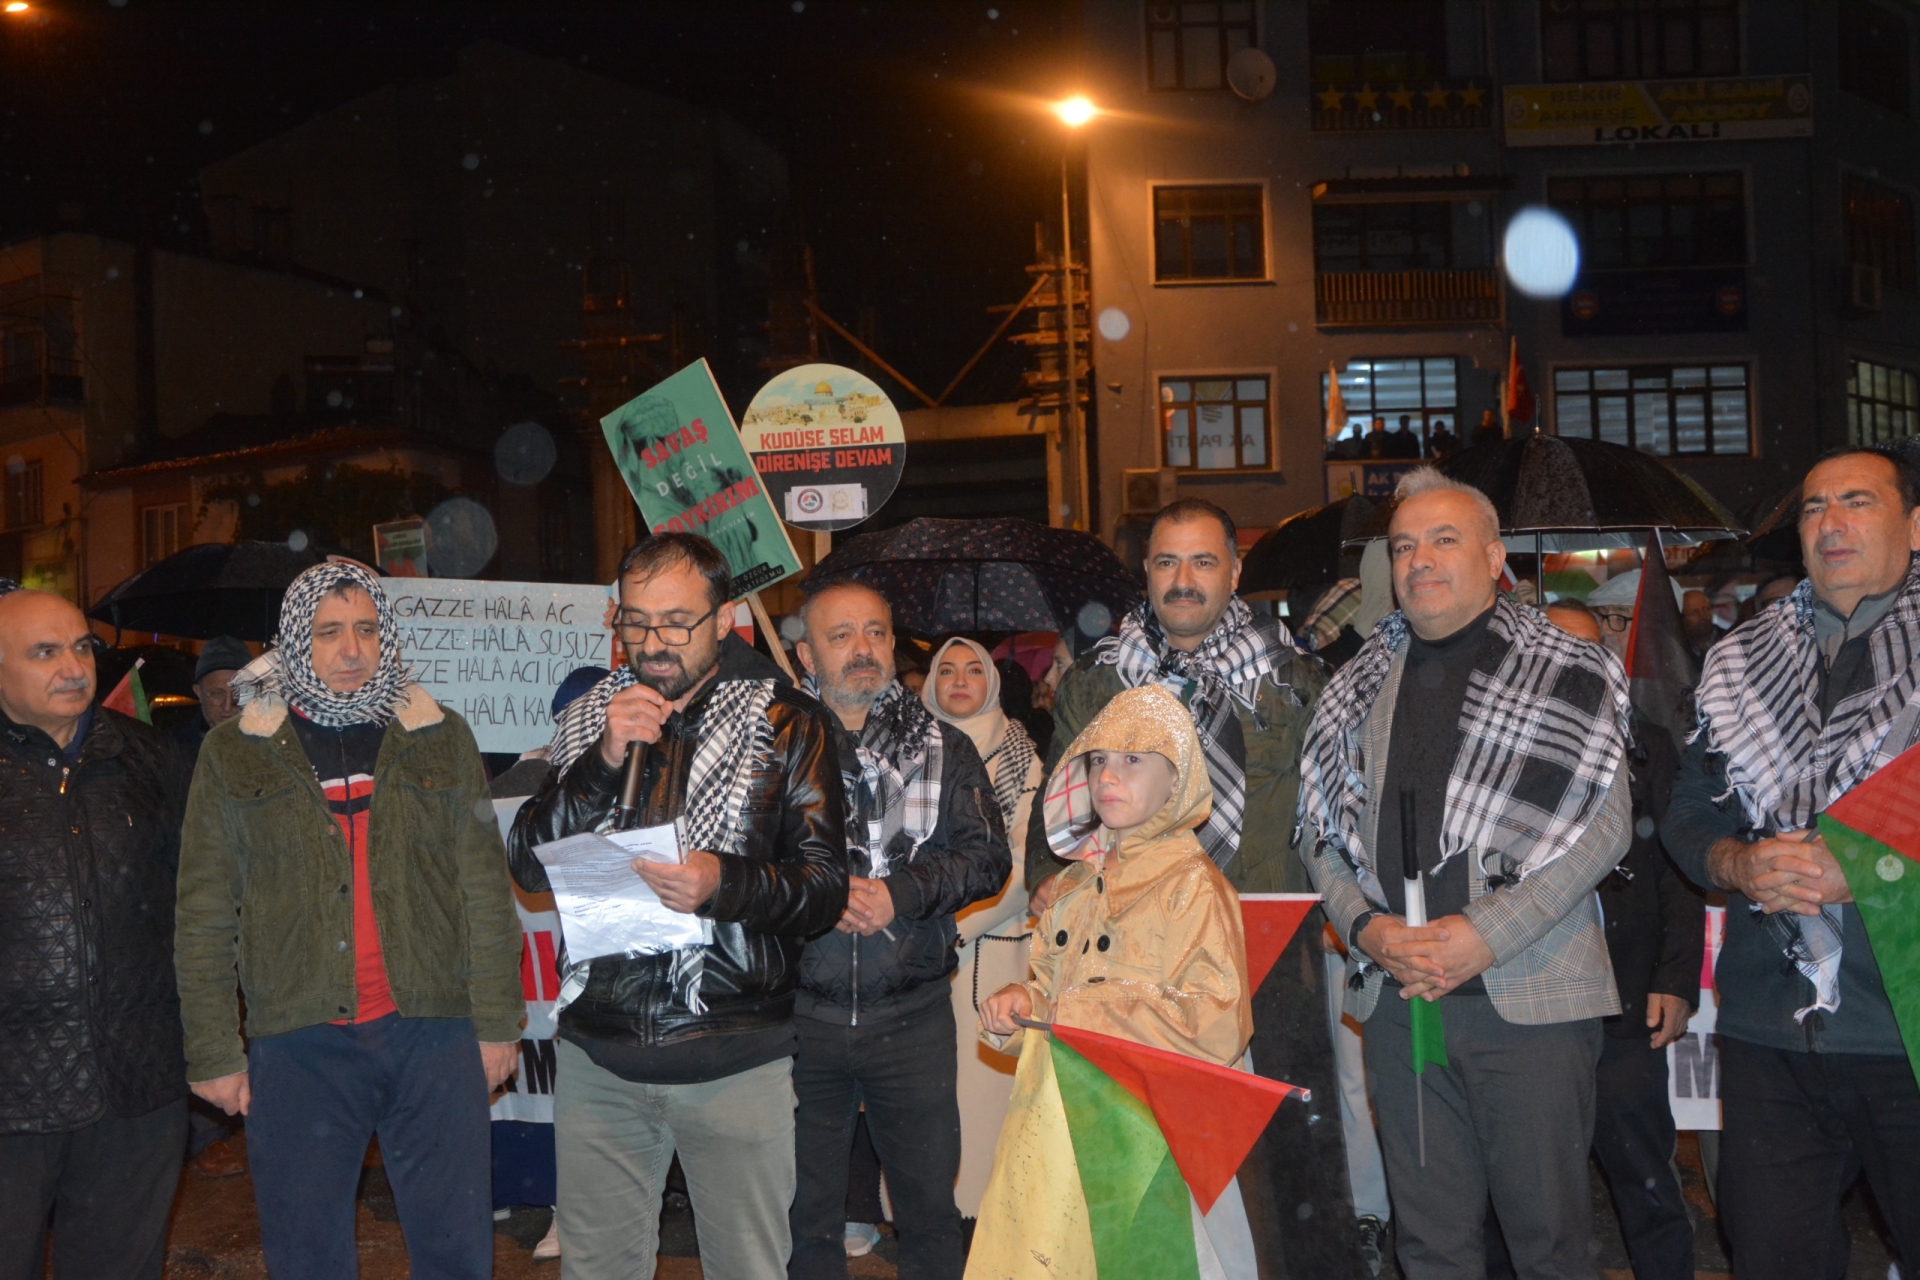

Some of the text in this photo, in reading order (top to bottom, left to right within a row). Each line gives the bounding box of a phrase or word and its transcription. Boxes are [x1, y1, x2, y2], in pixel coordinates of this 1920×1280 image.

[1595, 122, 1720, 142] LOKALİ
[641, 417, 708, 469] SAVAŞ
[760, 425, 884, 450] KUDÜSE SELAM
[756, 447, 892, 473] DİRENİŞE DEVAM
[656, 453, 722, 497] DEĞİL
[394, 595, 475, 618] GAZZE
[485, 595, 534, 621] HÂLÂ
[473, 624, 531, 652] HÂLÂ
[535, 629, 606, 660] SUSUZ
[458, 656, 504, 683] HÂLÂ
[464, 693, 518, 726] HÂLÂ
